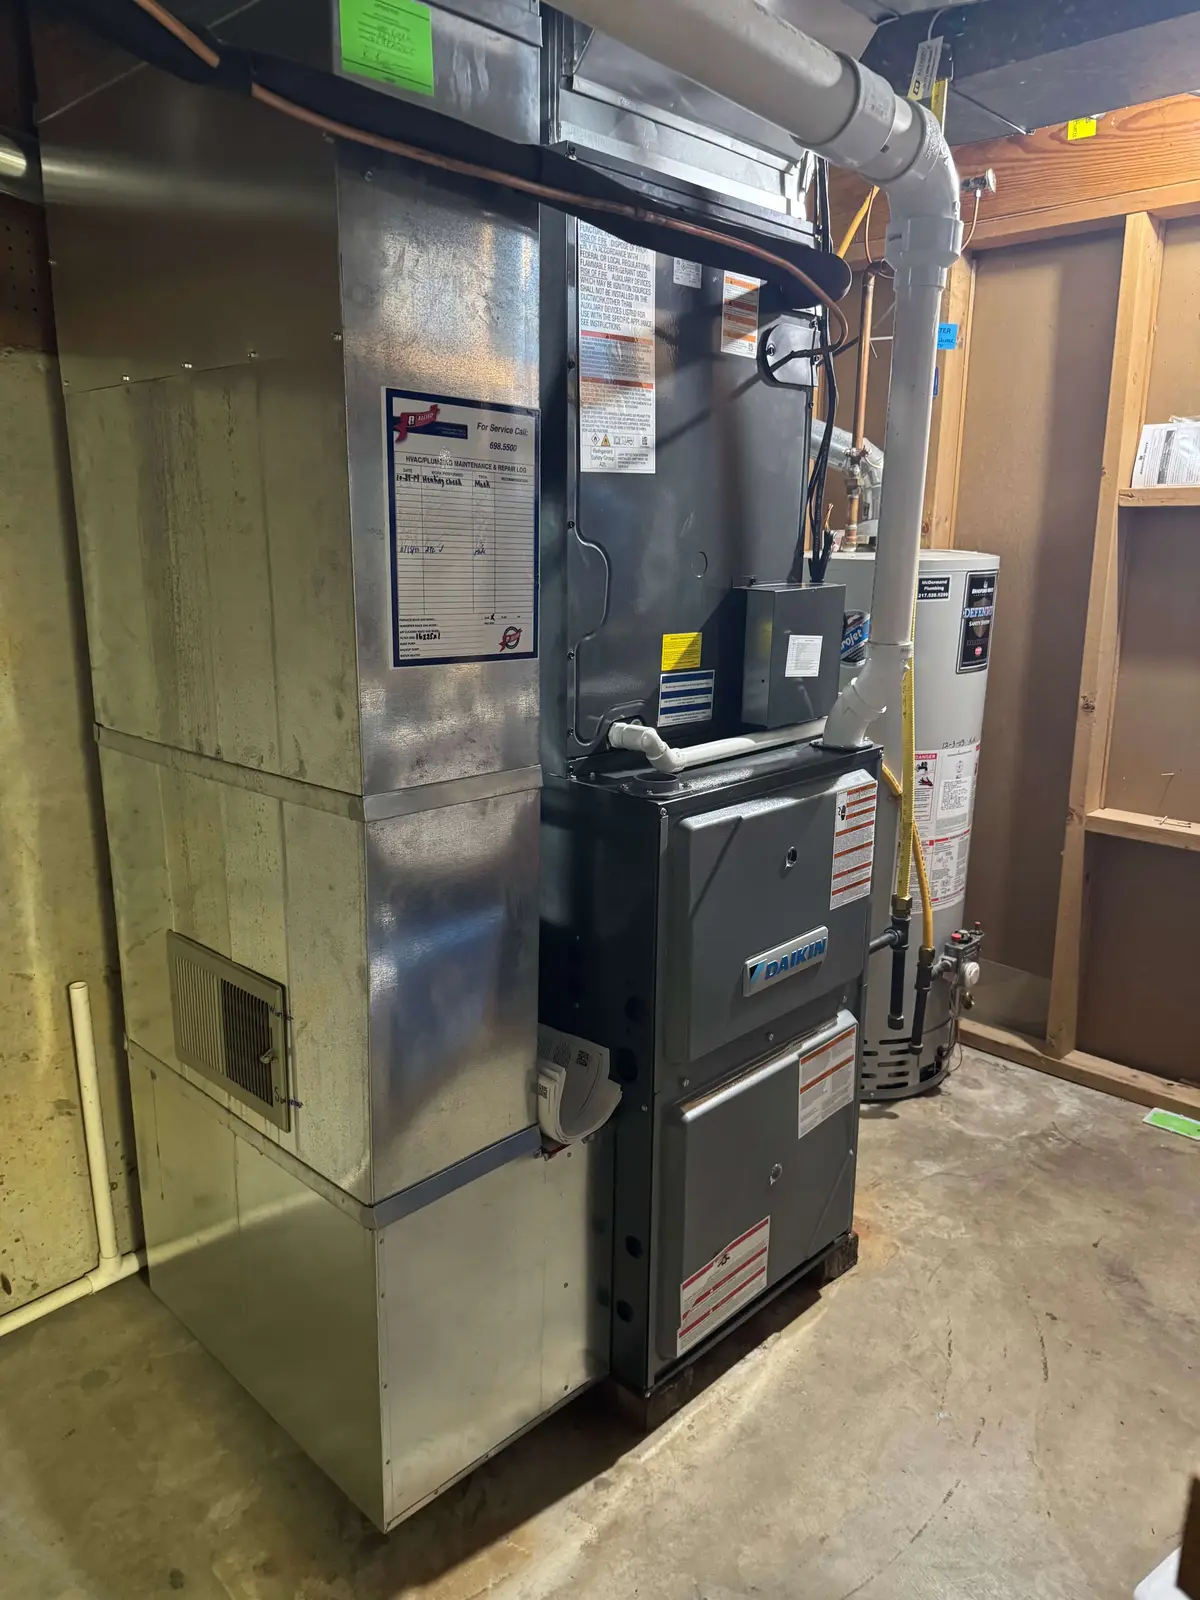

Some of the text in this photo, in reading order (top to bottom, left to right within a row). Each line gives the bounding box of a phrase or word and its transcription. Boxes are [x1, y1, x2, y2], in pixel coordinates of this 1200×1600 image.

[580, 250, 599, 260] FEDERAL
[608, 256, 620, 266] LOCAL
[580, 258, 606, 270] FLAMMABLE
[608, 264, 636, 276] REFRIGERANT
[580, 266, 590, 276] RISK
[634, 277, 651, 288] DEVICES
[580, 276, 595, 286] WHICH
[597, 279, 606, 288] MAY
[632, 286, 651, 296] SOURCES
[580, 284, 594, 294] SHALL
[581, 310, 590, 318] USE
[590, 312, 602, 320] WITH
[603, 313, 611, 322] THE
[604, 304, 622, 315] DEVICES
[581, 318, 590, 327] SEE
[476, 422, 488, 431] For
[490, 424, 514, 434] Service
[514, 428, 529, 436] Call:
[490, 442, 518, 452] 698.5500
[454, 460, 492, 470] MAINTENANCE
[498, 464, 516, 472] REPAIR
[764, 937, 826, 980] DAIKIN
